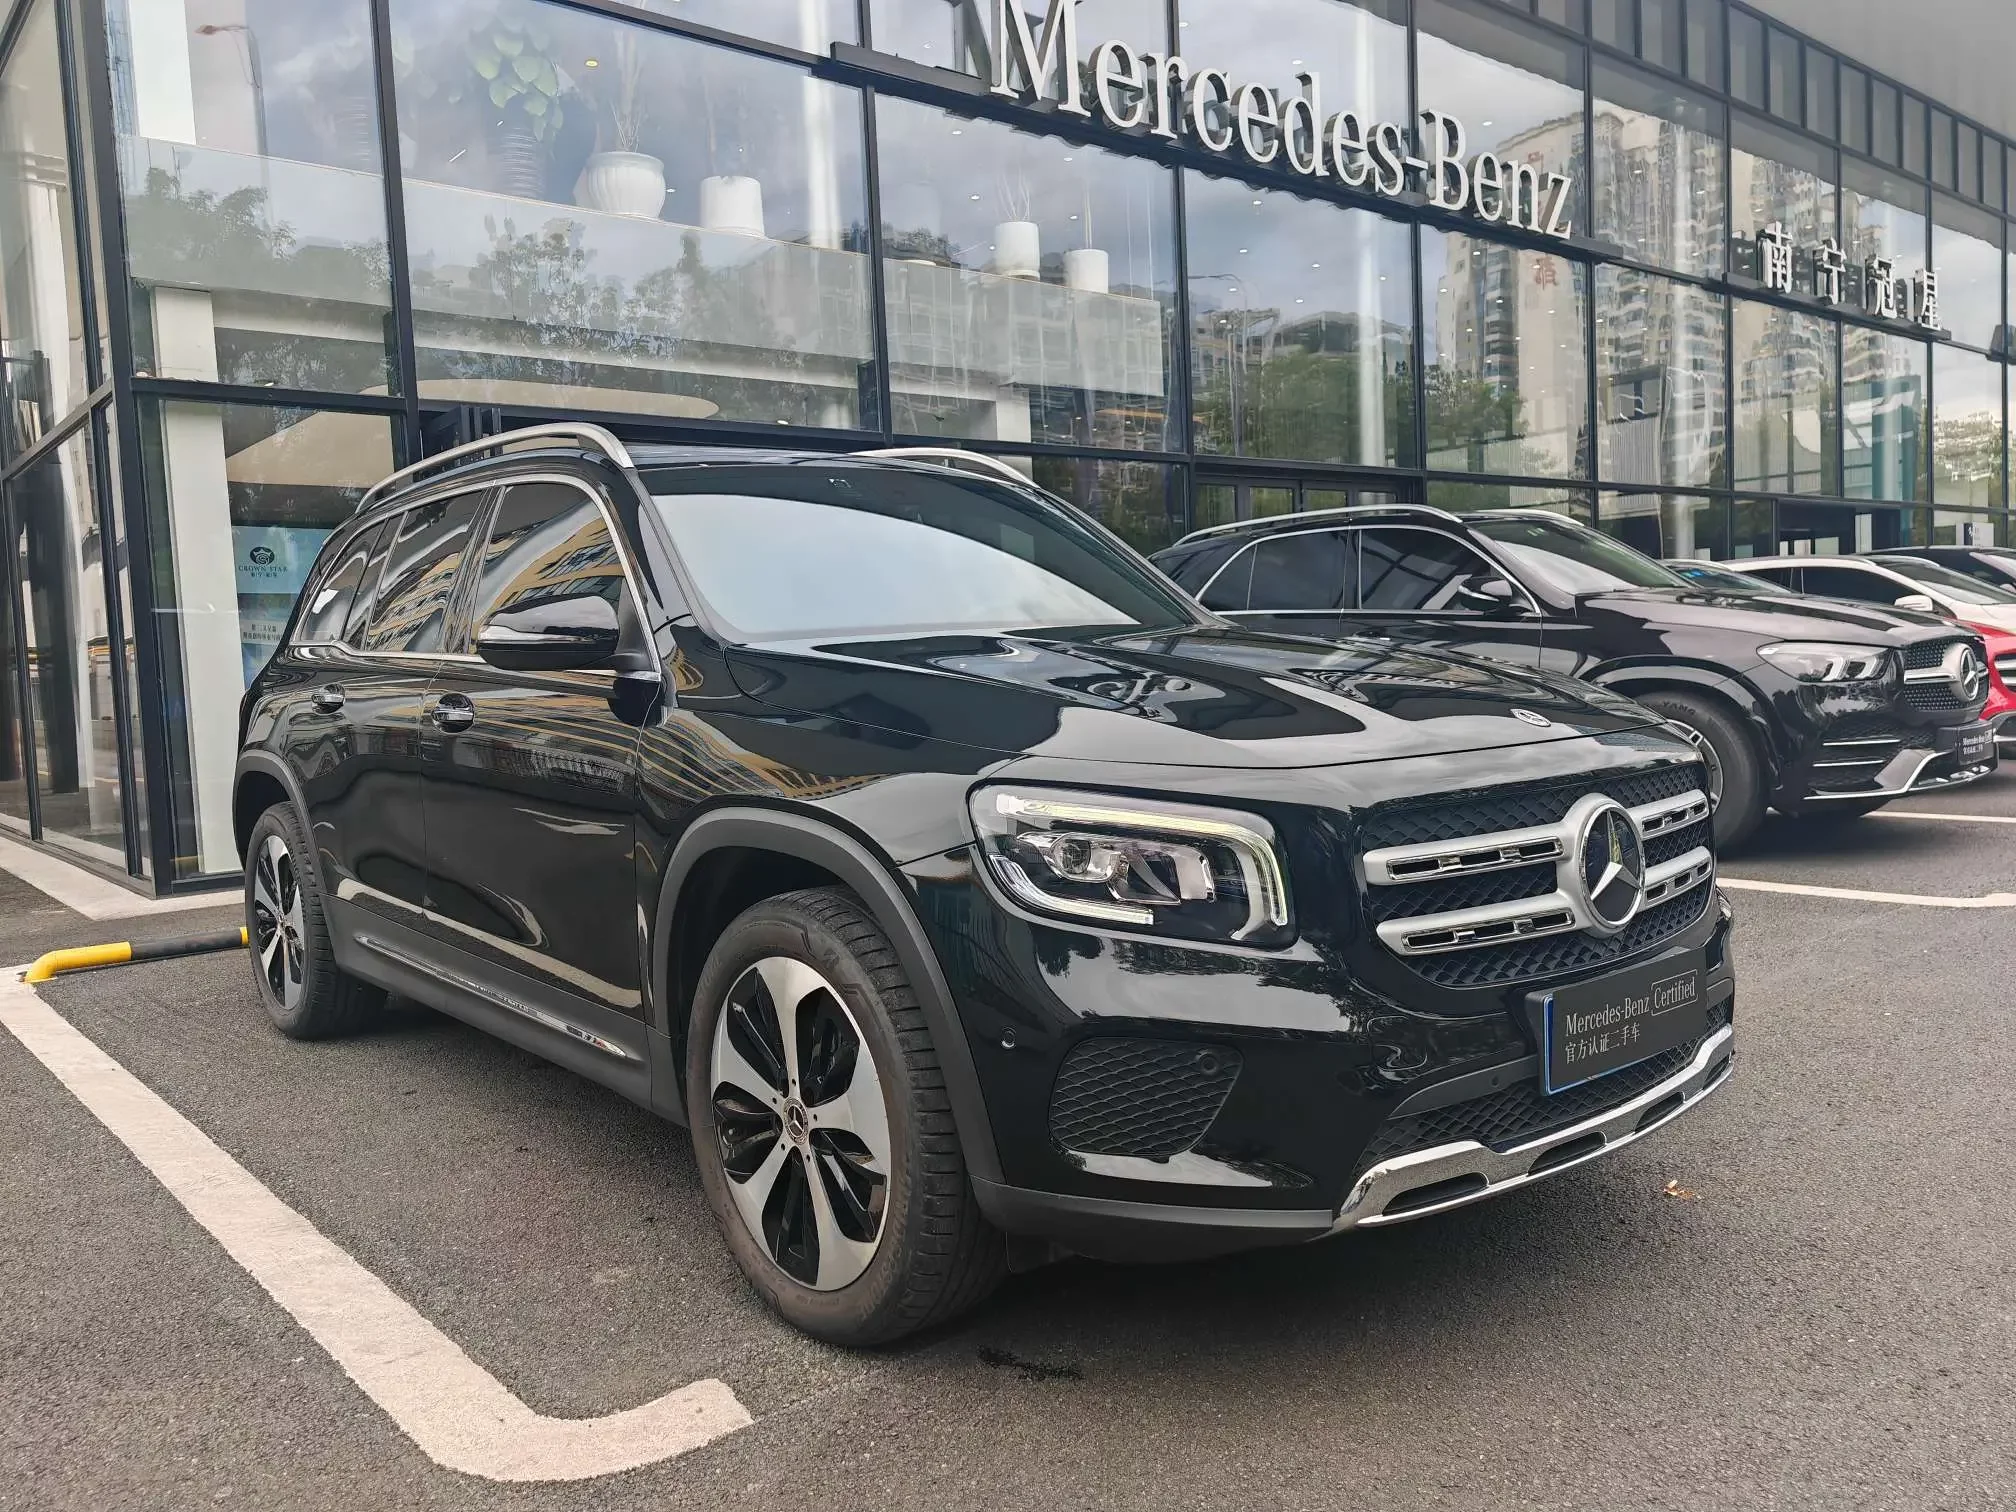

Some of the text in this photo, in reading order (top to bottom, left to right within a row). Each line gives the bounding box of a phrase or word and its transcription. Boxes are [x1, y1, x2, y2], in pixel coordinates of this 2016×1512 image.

[990, 0, 1572, 240] Mercedes-Benz
[1761, 221, 1941, 331] 南宁冠星
[1565, 1023, 1640, 1064] 官方认证二手车
[1566, 978, 1695, 1037] Mercedes-Benz Certified
